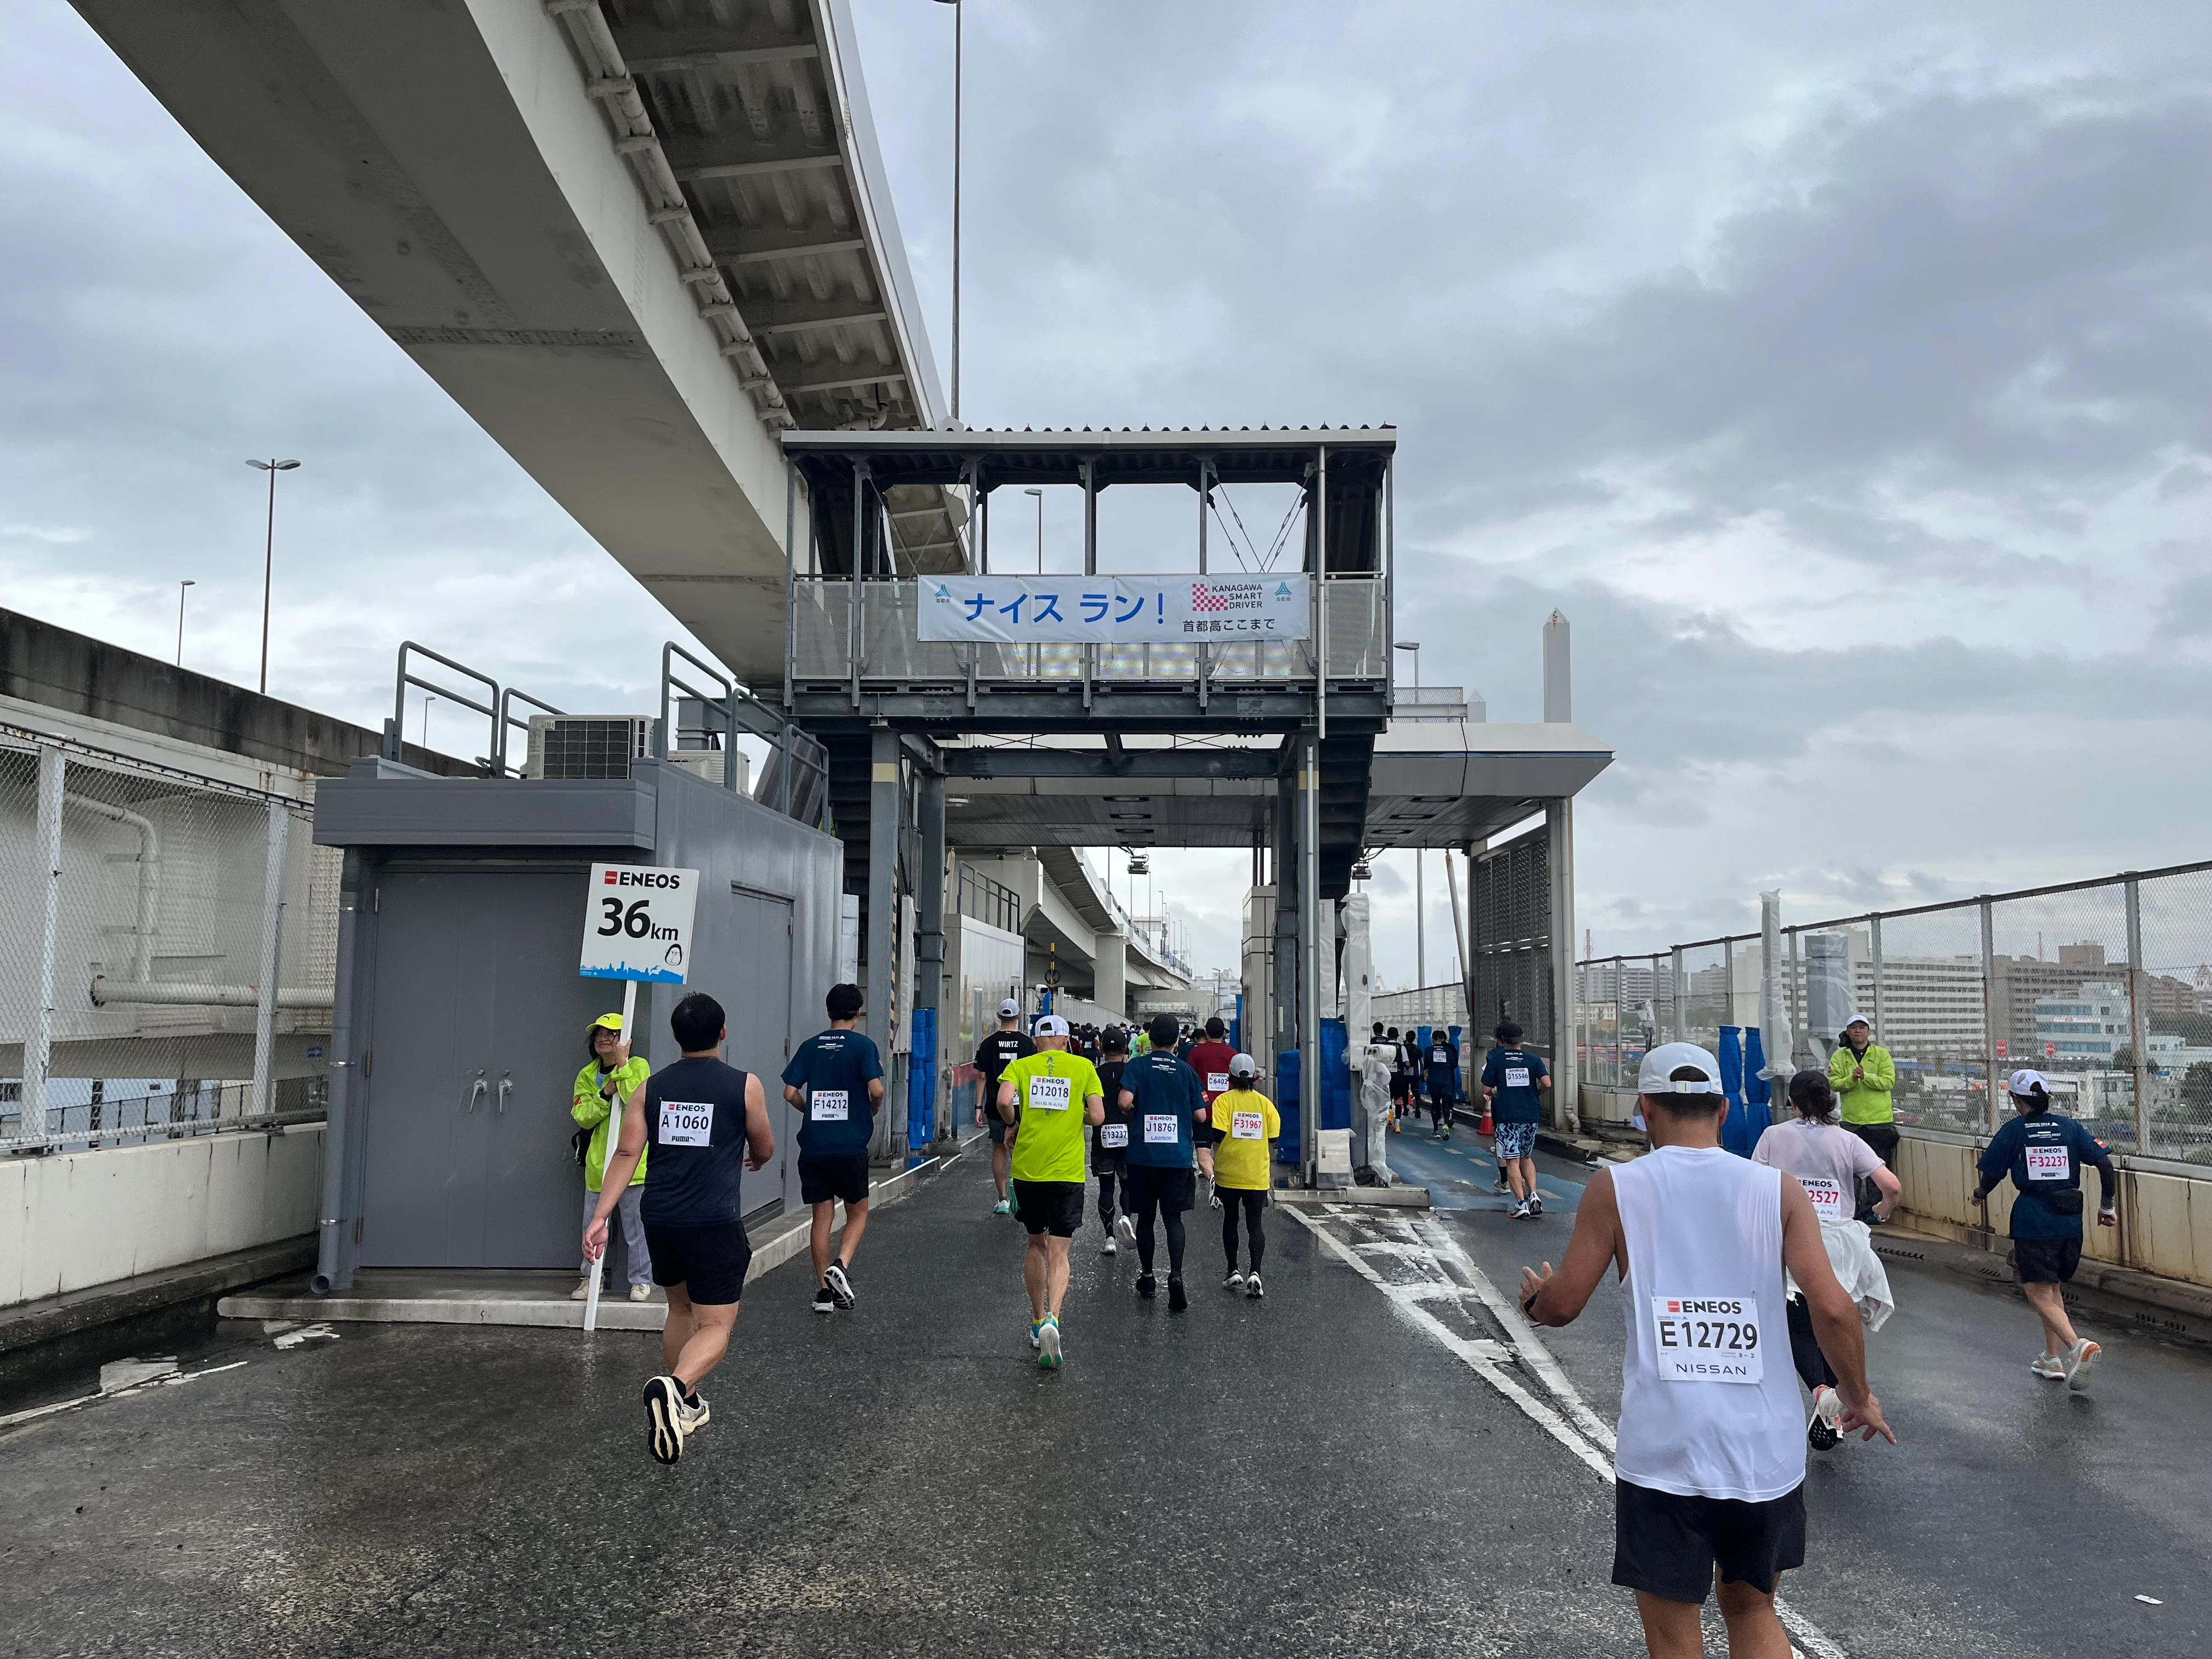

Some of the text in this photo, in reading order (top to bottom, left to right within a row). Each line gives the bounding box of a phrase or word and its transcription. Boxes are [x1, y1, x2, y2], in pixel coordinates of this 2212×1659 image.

[1212, 584, 1263, 592] KANAGAWA
[964, 593, 1063, 624] ナイス
[1182, 618, 1275, 632] 首都高ここまで
[619, 872, 680, 889] ENEOS
[1031, 1085, 1069, 1098] D12018
[814, 1099, 847, 1109] F14212
[1146, 1123, 1176, 1132] J18767
[1234, 1119, 1262, 1129] F31967
[1102, 1131, 1127, 1139] E13237
[2029, 1156, 2067, 1167] F32237
[1808, 1190, 1838, 1204] 2527
[1682, 1301, 1742, 1314] ENEOS
[1660, 1321, 1758, 1350] E12729
[1676, 1363, 1746, 1375] NISSAN
